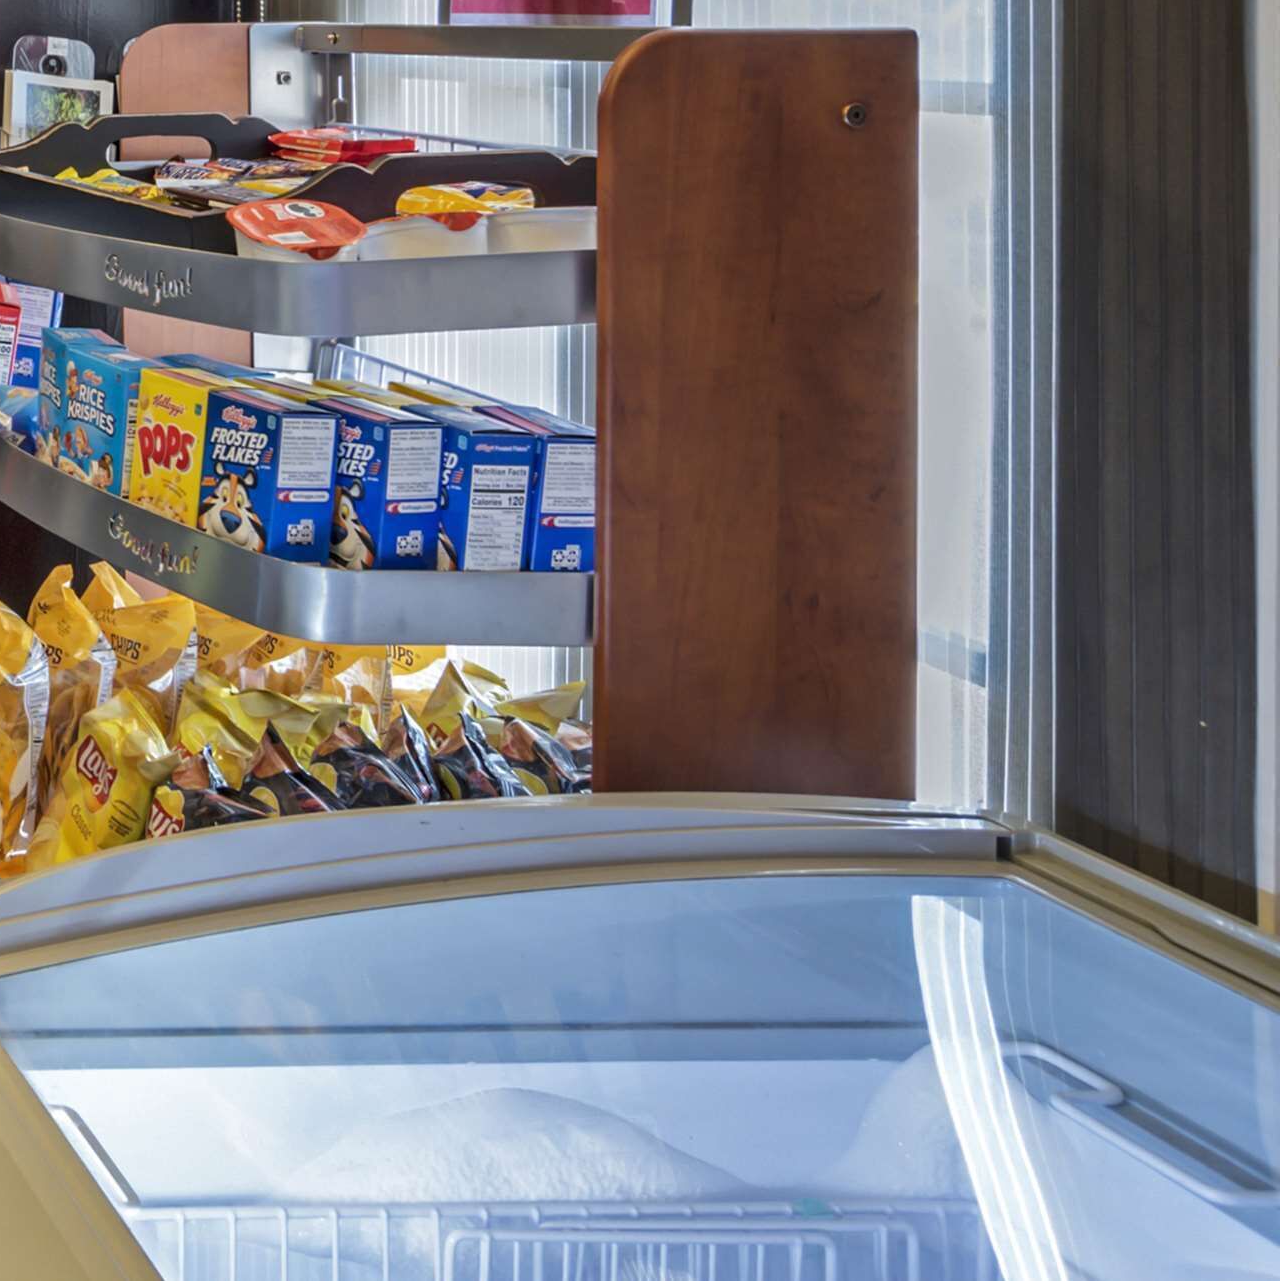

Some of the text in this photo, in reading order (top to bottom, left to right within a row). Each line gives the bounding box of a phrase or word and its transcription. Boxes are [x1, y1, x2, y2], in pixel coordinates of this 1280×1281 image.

[78, 383, 106, 410] RICE
[67, 399, 115, 436] KRISPIES
[137, 422, 197, 478] POPS
[210, 427, 269, 450] FROSTED
[212, 444, 262, 466] FLAKES
[473, 467, 527, 477] Nutrition Facts
[471, 496, 525, 507] Calories 120
[110, 632, 142, 660] CHIPS
